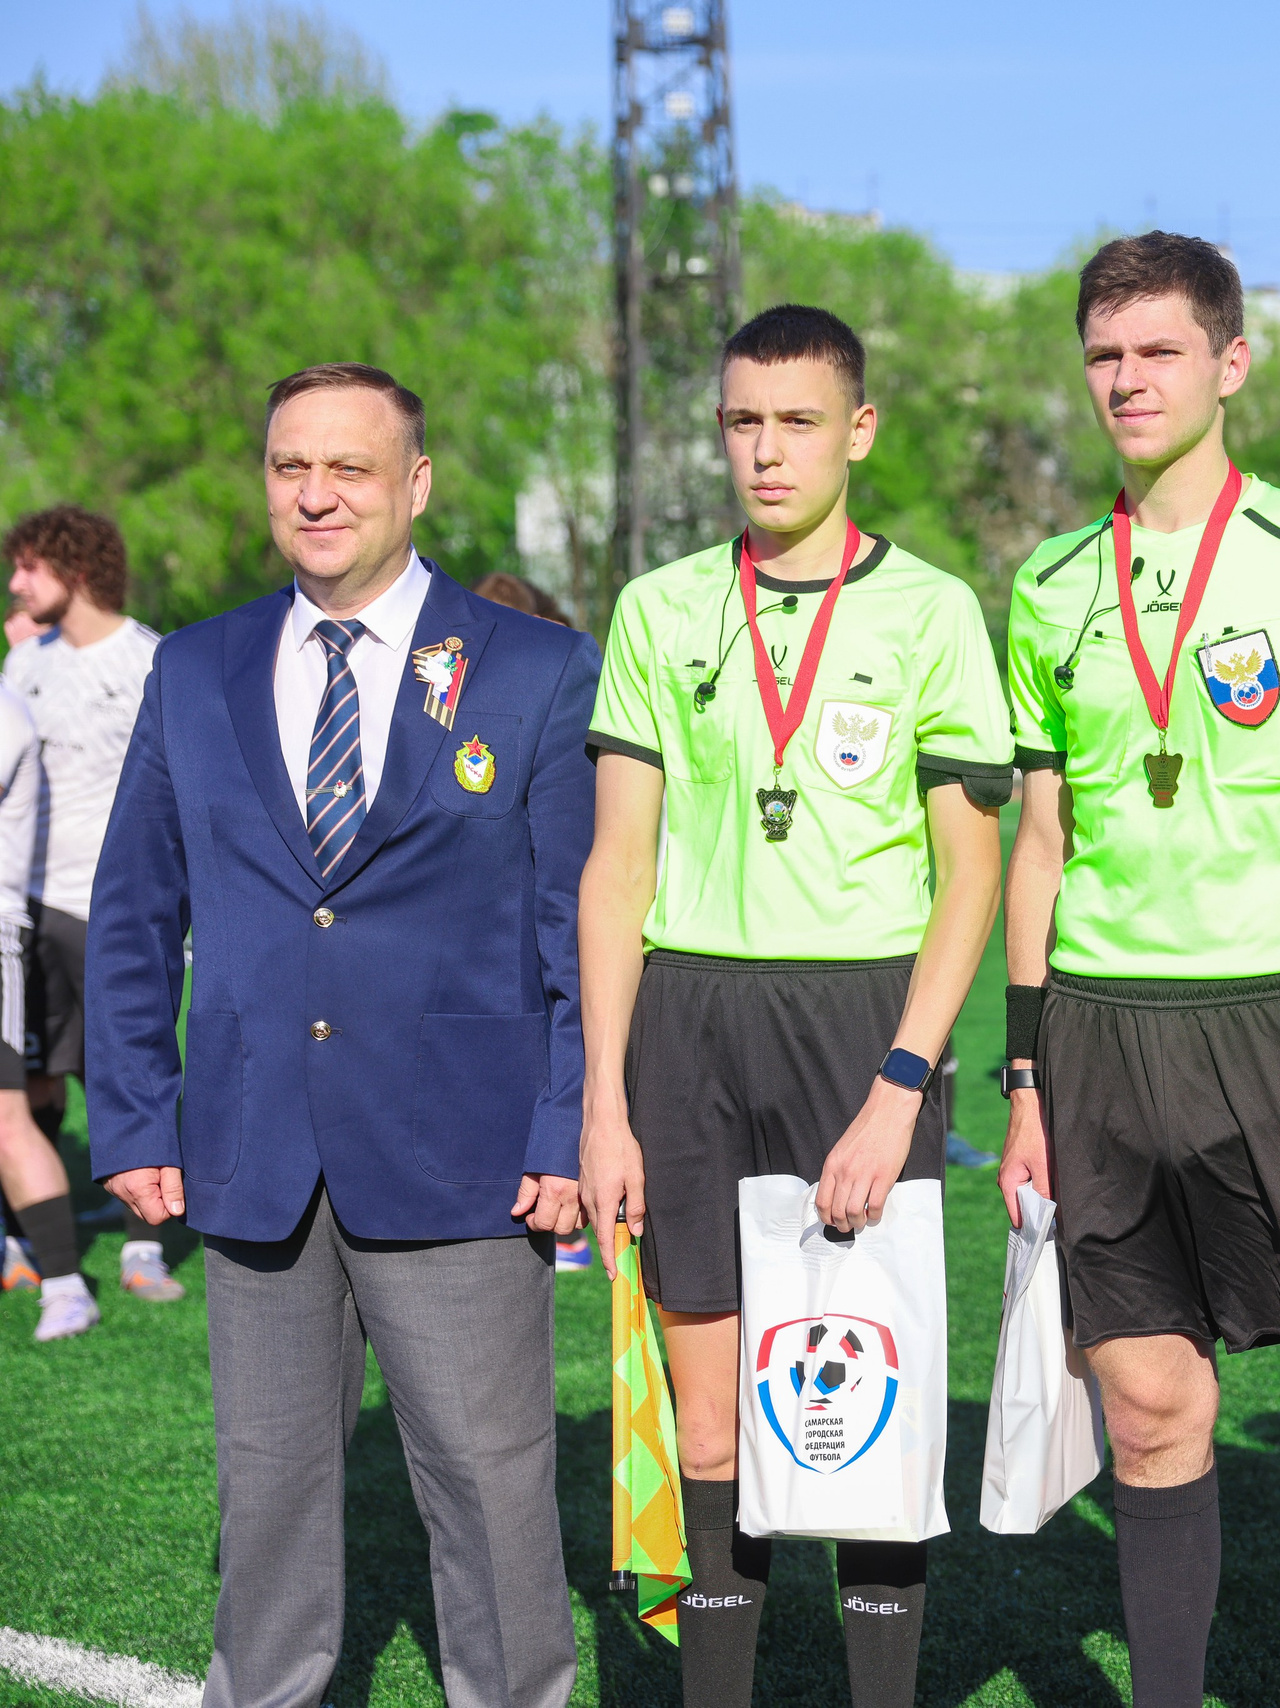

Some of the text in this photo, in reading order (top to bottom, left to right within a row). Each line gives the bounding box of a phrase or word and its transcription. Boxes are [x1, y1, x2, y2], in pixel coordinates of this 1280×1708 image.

[804, 1417, 844, 1428] САМАРСКАЯ
[805, 1429, 844, 1439] ГОРОДСКАЯ
[804, 1441, 845, 1451] ФЕДЕРАЦИЯ
[809, 1452, 841, 1462] ФУТБОЛА
[681, 1593, 753, 1608] JÖGEL
[843, 1596, 908, 1614] JÖGEL
